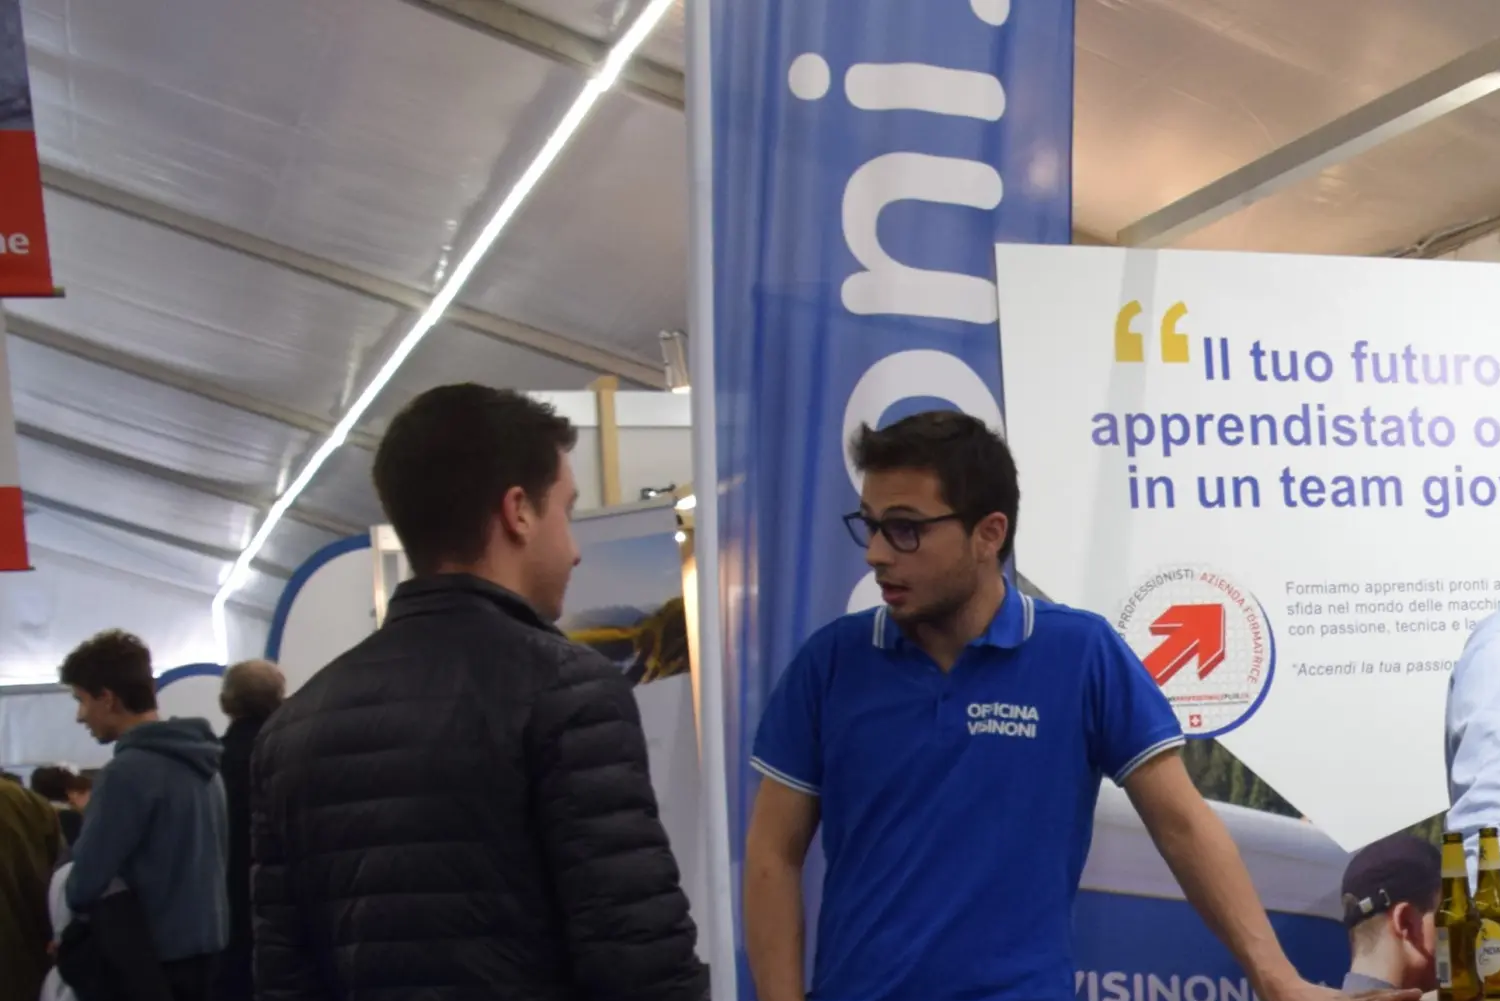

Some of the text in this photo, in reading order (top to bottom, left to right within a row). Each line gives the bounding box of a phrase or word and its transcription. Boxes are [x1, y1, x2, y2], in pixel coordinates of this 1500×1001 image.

[1203, 336, 1231, 381] Il
[1249, 340, 1334, 383] tuo
[1350, 340, 1500, 388] futuro
[1090, 403, 1456, 458] apprendistato
[1128, 464, 1176, 509] in
[1196, 475, 1261, 509] un
[1279, 466, 1404, 508] team
[1285, 580, 1360, 595] Formiamo
[1364, 579, 1444, 596] apprendisti
[1449, 579, 1488, 594] pronti
[1286, 601, 1323, 616] sfida
[1328, 600, 1350, 614] nel
[1355, 599, 1404, 614] mondo
[1408, 598, 1443, 612] delle
[1118, 568, 1265, 685] PROFESSIONISTI AZIENDA FORMATRICE
[1288, 624, 1315, 636] con
[1320, 620, 1392, 638] passione,
[1395, 618, 1447, 633] tecnica
[1451, 620, 1461, 631] e
[1361, 660, 1374, 674] la
[1379, 660, 1401, 674] tua
